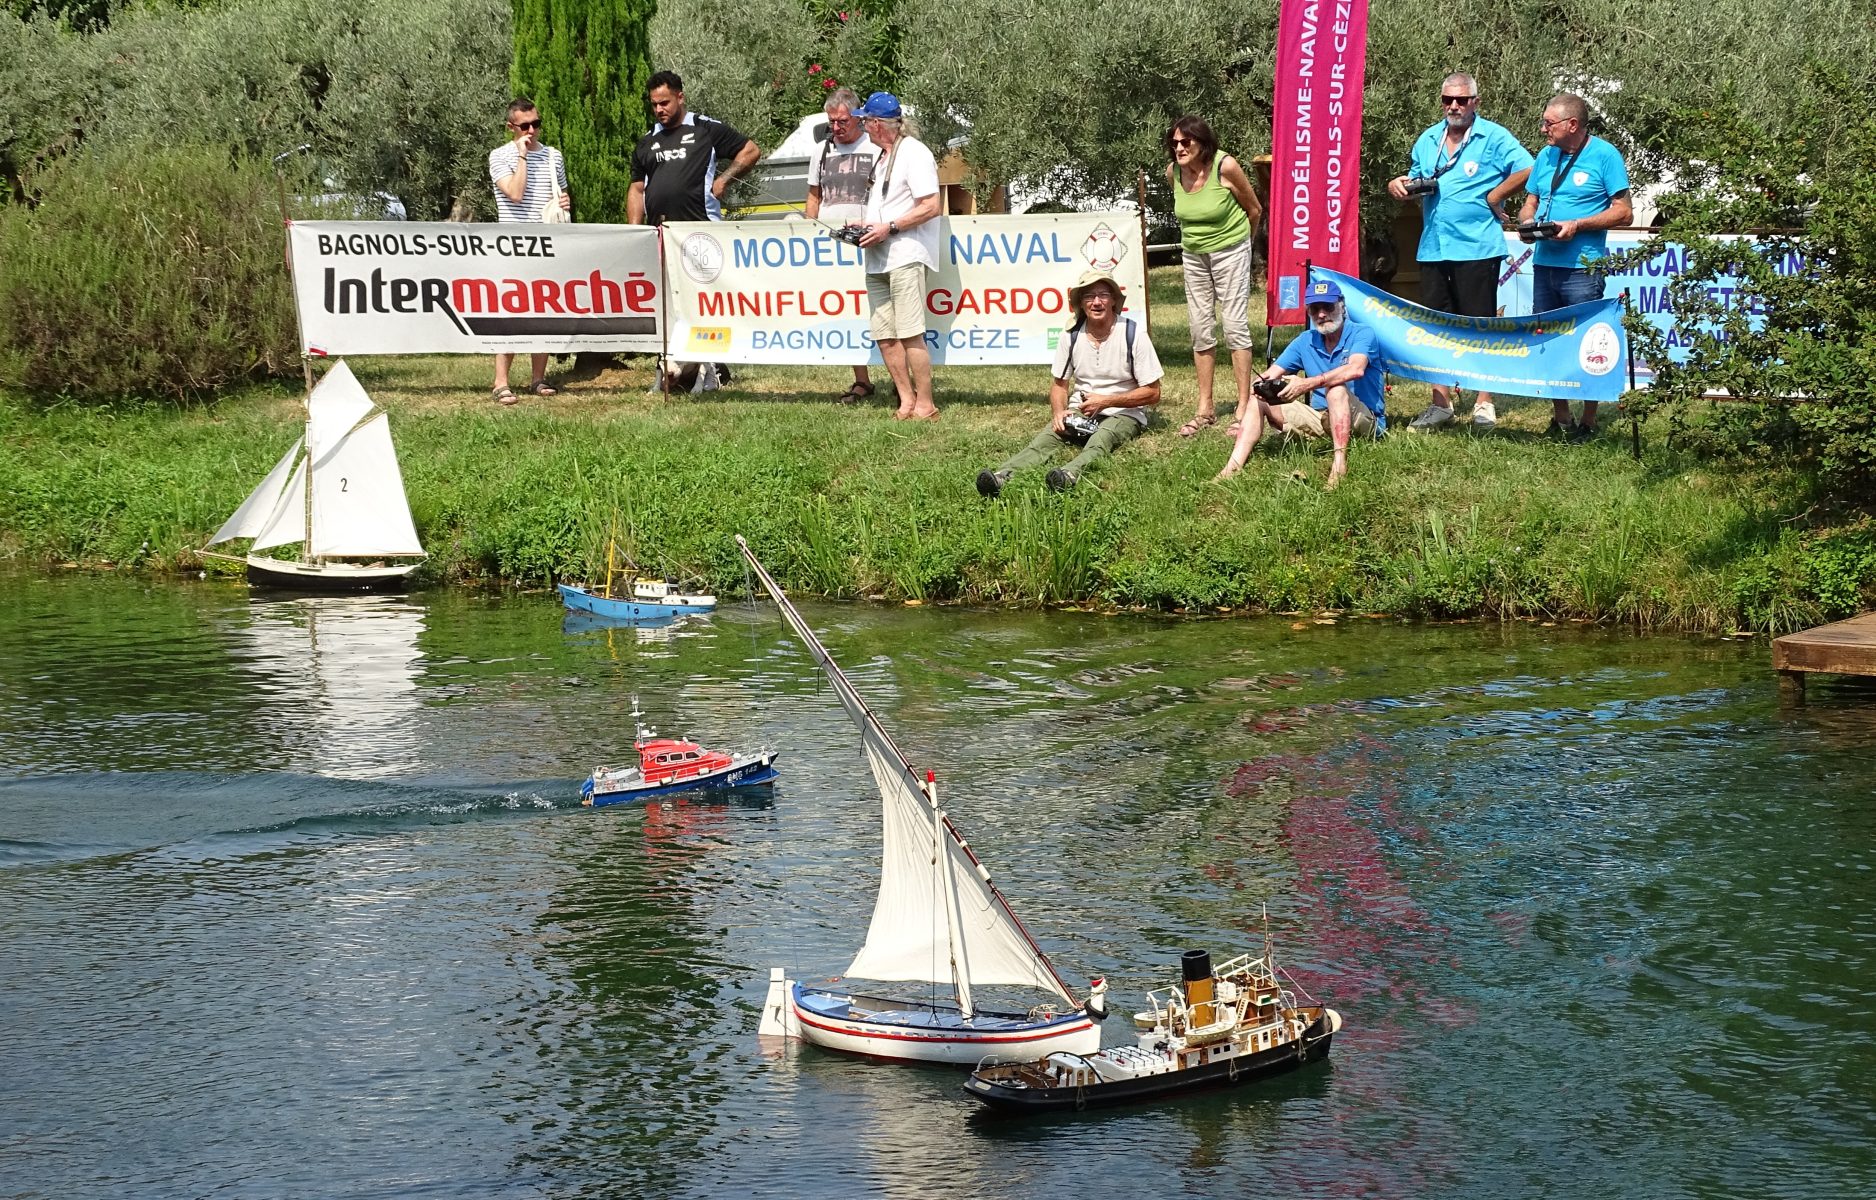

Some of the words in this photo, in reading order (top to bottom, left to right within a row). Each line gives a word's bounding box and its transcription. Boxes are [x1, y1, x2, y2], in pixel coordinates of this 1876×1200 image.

[1292, 0, 1320, 250] MODÉLISME-NAVA
[1326, 0, 1353, 253] BAGNOLS-SUR-CÈZ
[655, 147, 687, 163] INEOS
[318, 233, 555, 258] BAGNOLS-SUR-CEZE
[734, 228, 863, 269] MODÉLI
[950, 232, 1071, 267] NAVAL
[698, 289, 868, 318] MINIFLOT
[752, 329, 876, 350] BAGNOLS
[948, 324, 1020, 349] CÈZE
[341, 478, 348, 492] 2
